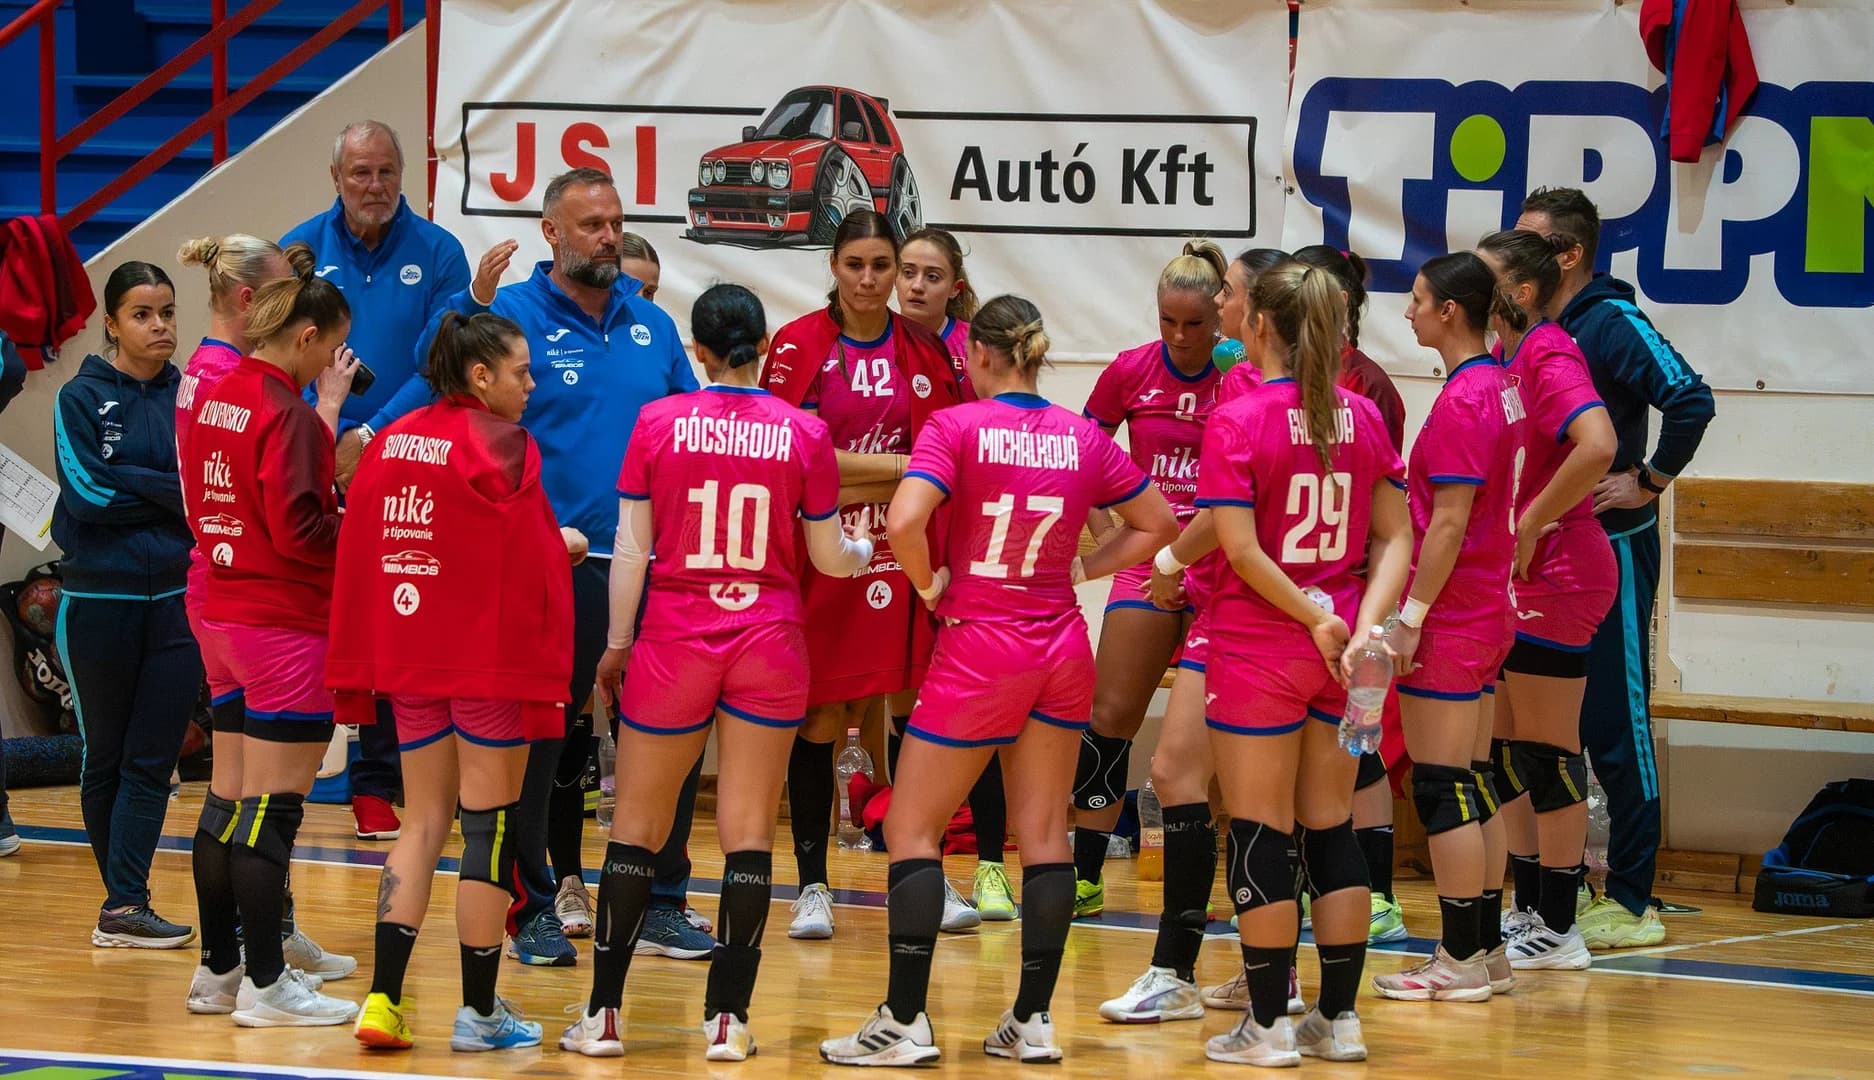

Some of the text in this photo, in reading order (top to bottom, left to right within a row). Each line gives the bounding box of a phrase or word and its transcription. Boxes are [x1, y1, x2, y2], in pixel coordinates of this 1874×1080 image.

[489, 121, 1214, 206] JSI Autó Kft
[851, 358, 894, 397] 42
[382, 433, 453, 465] SLOVENSKO
[673, 407, 792, 462] PÓCSÍKOVÁ
[978, 423, 1079, 471] MICHÁLKOVÁ
[1151, 447, 1200, 480] nik
[383, 485, 434, 524] niké
[1281, 472, 1352, 563] 29
[382, 525, 433, 540] je tipovanie
[685, 480, 771, 571] 10
[969, 493, 1064, 578] 17
[612, 863, 646, 876] ROYAL
[733, 873, 765, 886] ROYAL
